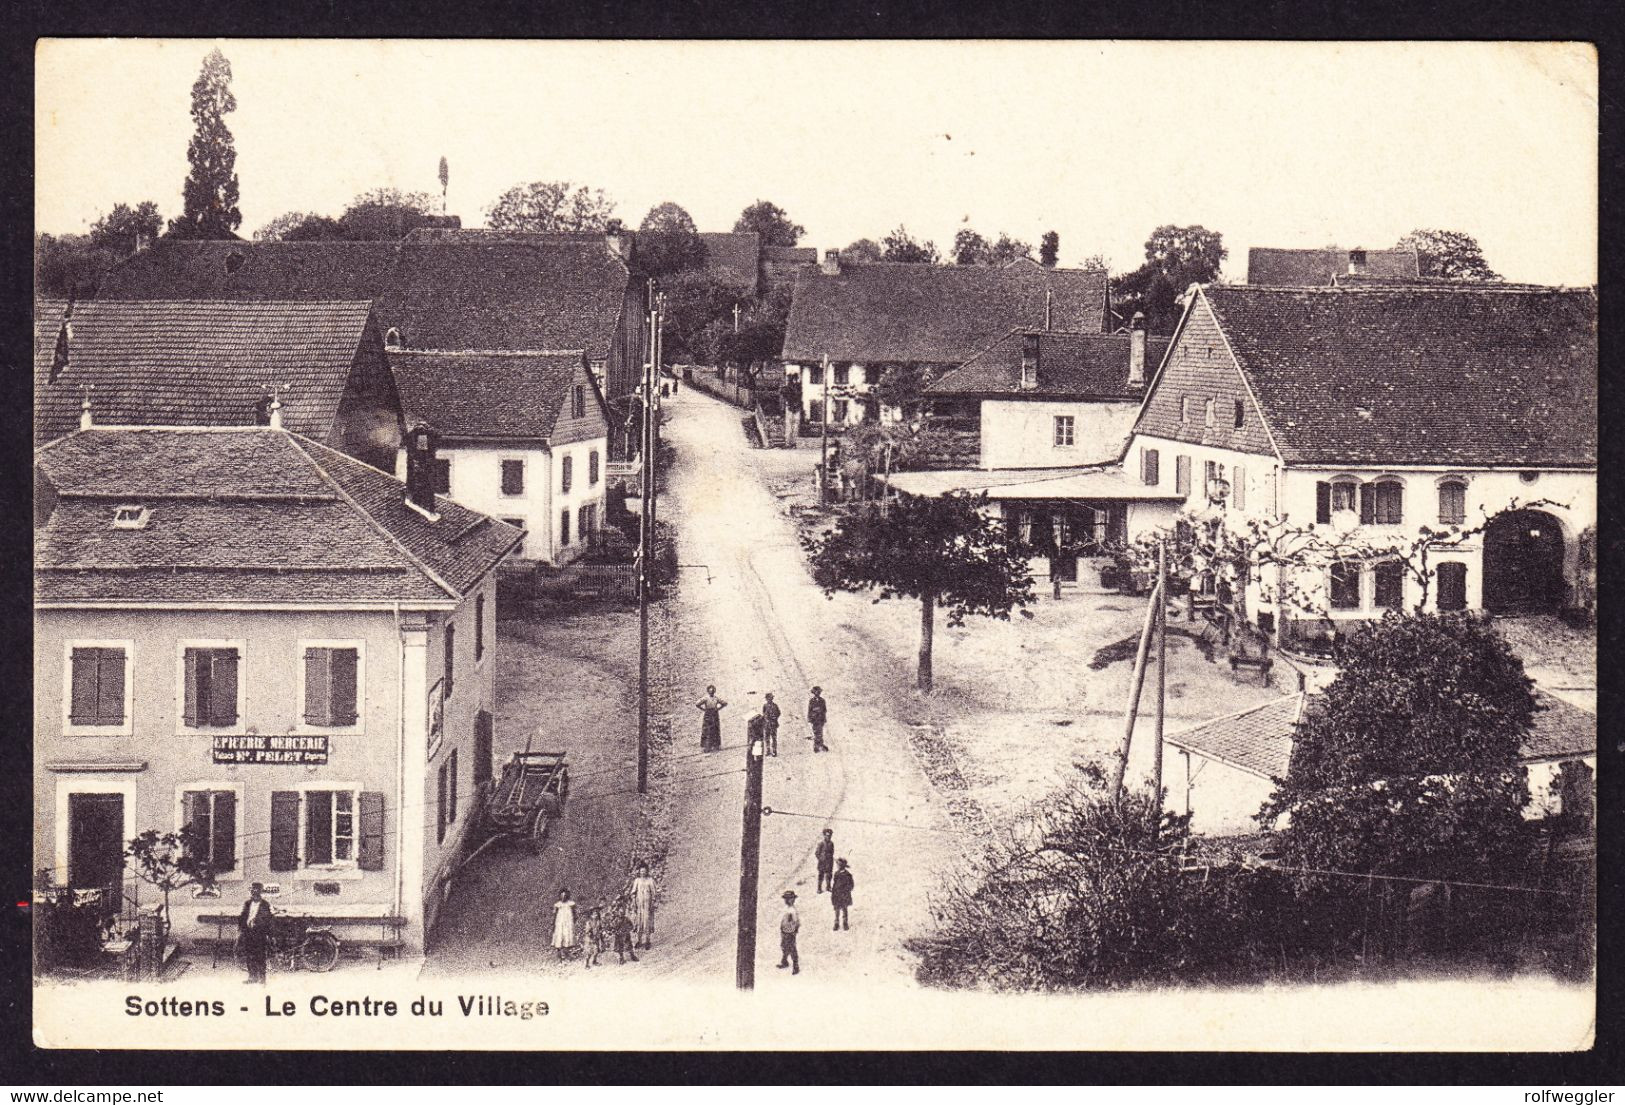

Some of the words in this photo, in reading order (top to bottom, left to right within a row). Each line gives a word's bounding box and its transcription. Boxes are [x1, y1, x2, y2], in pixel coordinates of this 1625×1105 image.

[214, 737, 266, 749] EPICERIE
[270, 737, 326, 750] MERCERIE
[256, 751, 303, 762] PELET
